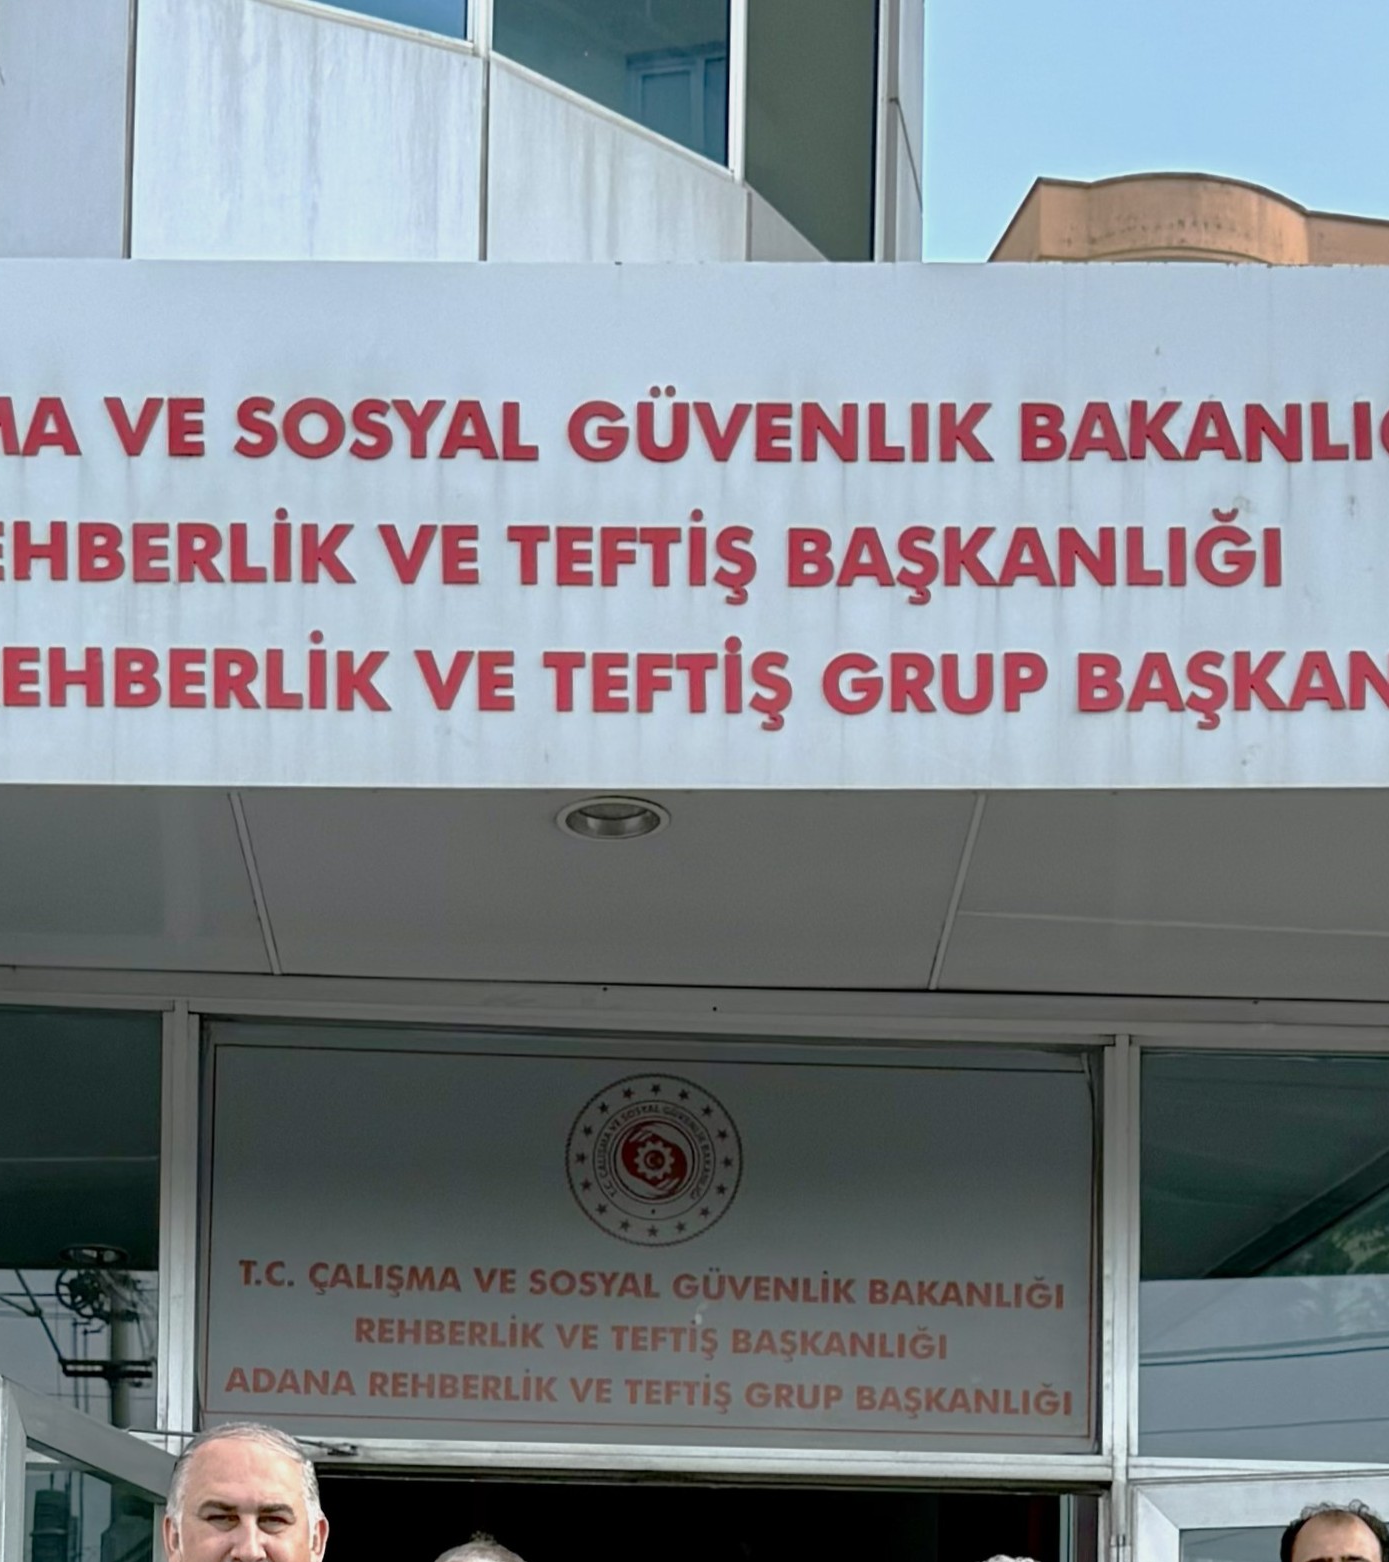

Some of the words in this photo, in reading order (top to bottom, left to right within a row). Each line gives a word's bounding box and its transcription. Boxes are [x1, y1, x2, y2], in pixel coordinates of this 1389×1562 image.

[106, 397, 204, 458] VE
[236, 397, 538, 461] SOSYAL
[379, 525, 480, 585] VE
[507, 508, 757, 605] TEFTİŞ
[787, 507, 1282, 605] BAŞKANLIĞI
[415, 650, 515, 713] VE
[542, 635, 792, 732] TEFTİŞ
[822, 652, 1049, 716] GRUP
[239, 1260, 295, 1287] T.C.
[308, 1262, 462, 1298] ÇALIŞMA
[473, 1267, 517, 1295] VE
[529, 1269, 660, 1299] SOSYAL
[672, 1267, 857, 1305] GÜVENLİK
[868, 1276, 1065, 1310] BAKANLIĞI
[355, 1315, 545, 1348] REHBERLİK
[556, 1323, 600, 1351] VE
[612, 1320, 719, 1361] TEFTİŞ
[731, 1326, 948, 1363] BAŞKANLIĞI
[224, 1366, 356, 1397] ADANA
[369, 1368, 559, 1403] REHBERLİK
[569, 1378, 613, 1405] VE
[625, 1373, 732, 1414] TEFTİŞ
[745, 1382, 843, 1412] GRUP
[856, 1382, 1074, 1419] BAŞKANLIĞI
